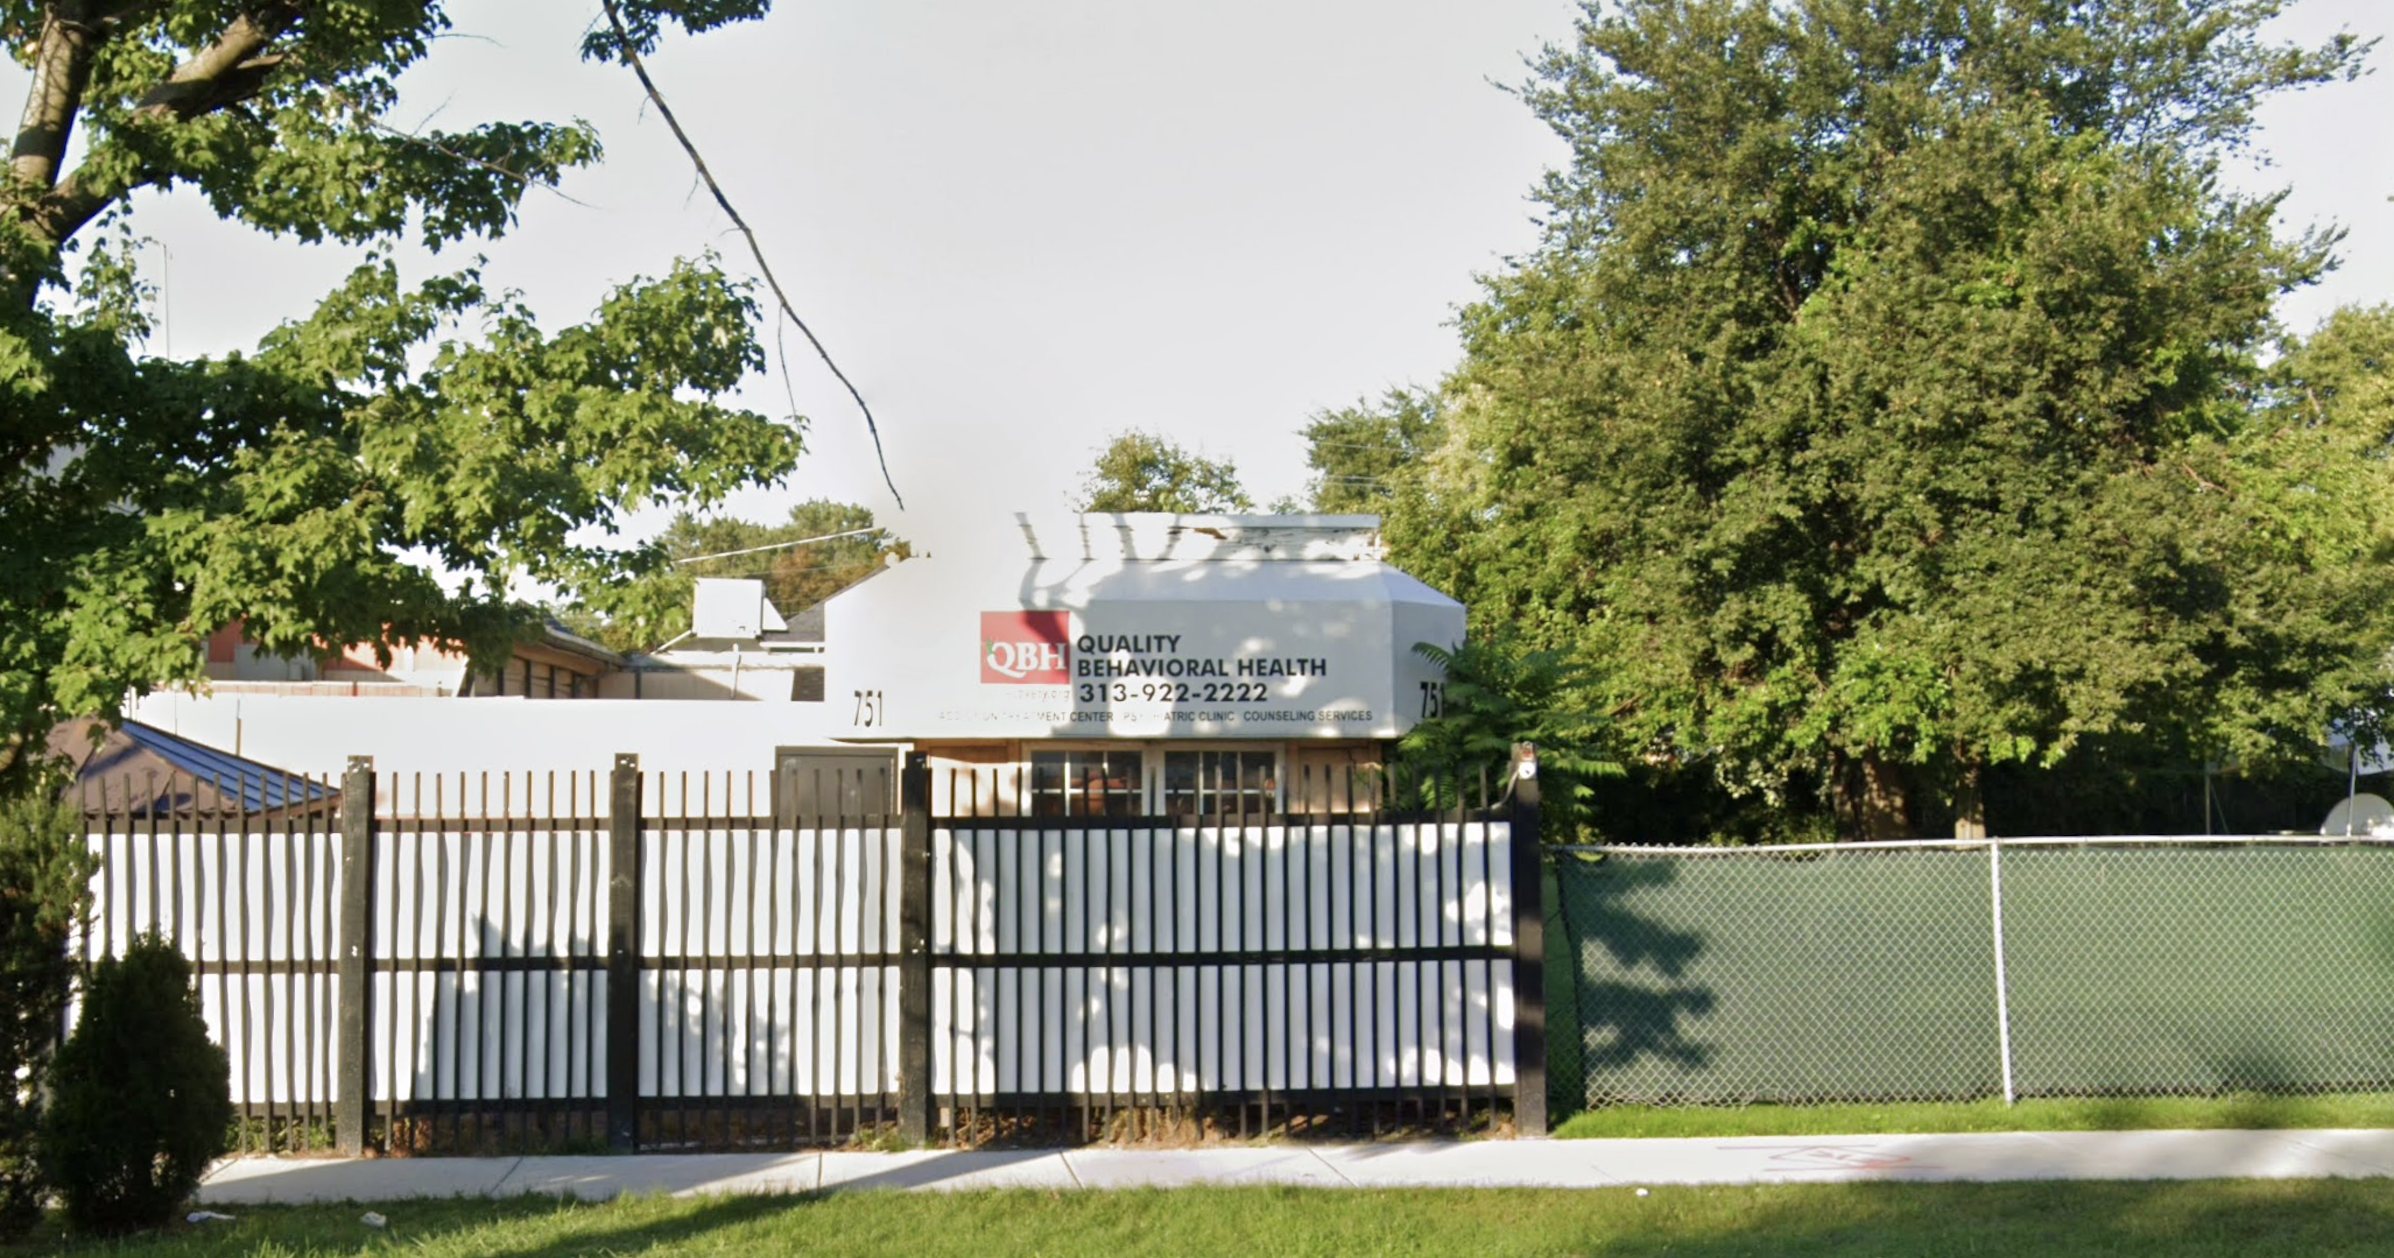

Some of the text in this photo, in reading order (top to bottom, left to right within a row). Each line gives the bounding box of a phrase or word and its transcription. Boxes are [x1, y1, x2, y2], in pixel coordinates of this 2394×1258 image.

[1077, 634, 1182, 655] QUALITY
[987, 641, 1067, 679] QBH
[1078, 658, 1327, 677] BEHAVIORAL HEALTH
[1080, 683, 1268, 702] 313-922-2222
[854, 690, 882, 728] 751
[1069, 711, 1114, 722] CENTER
[1123, 711, 1195, 722] PSATRIC
[1198, 710, 1235, 722] CLINIC
[1243, 710, 1316, 722] COUNSELING
[1318, 710, 1373, 721] SERVICES
